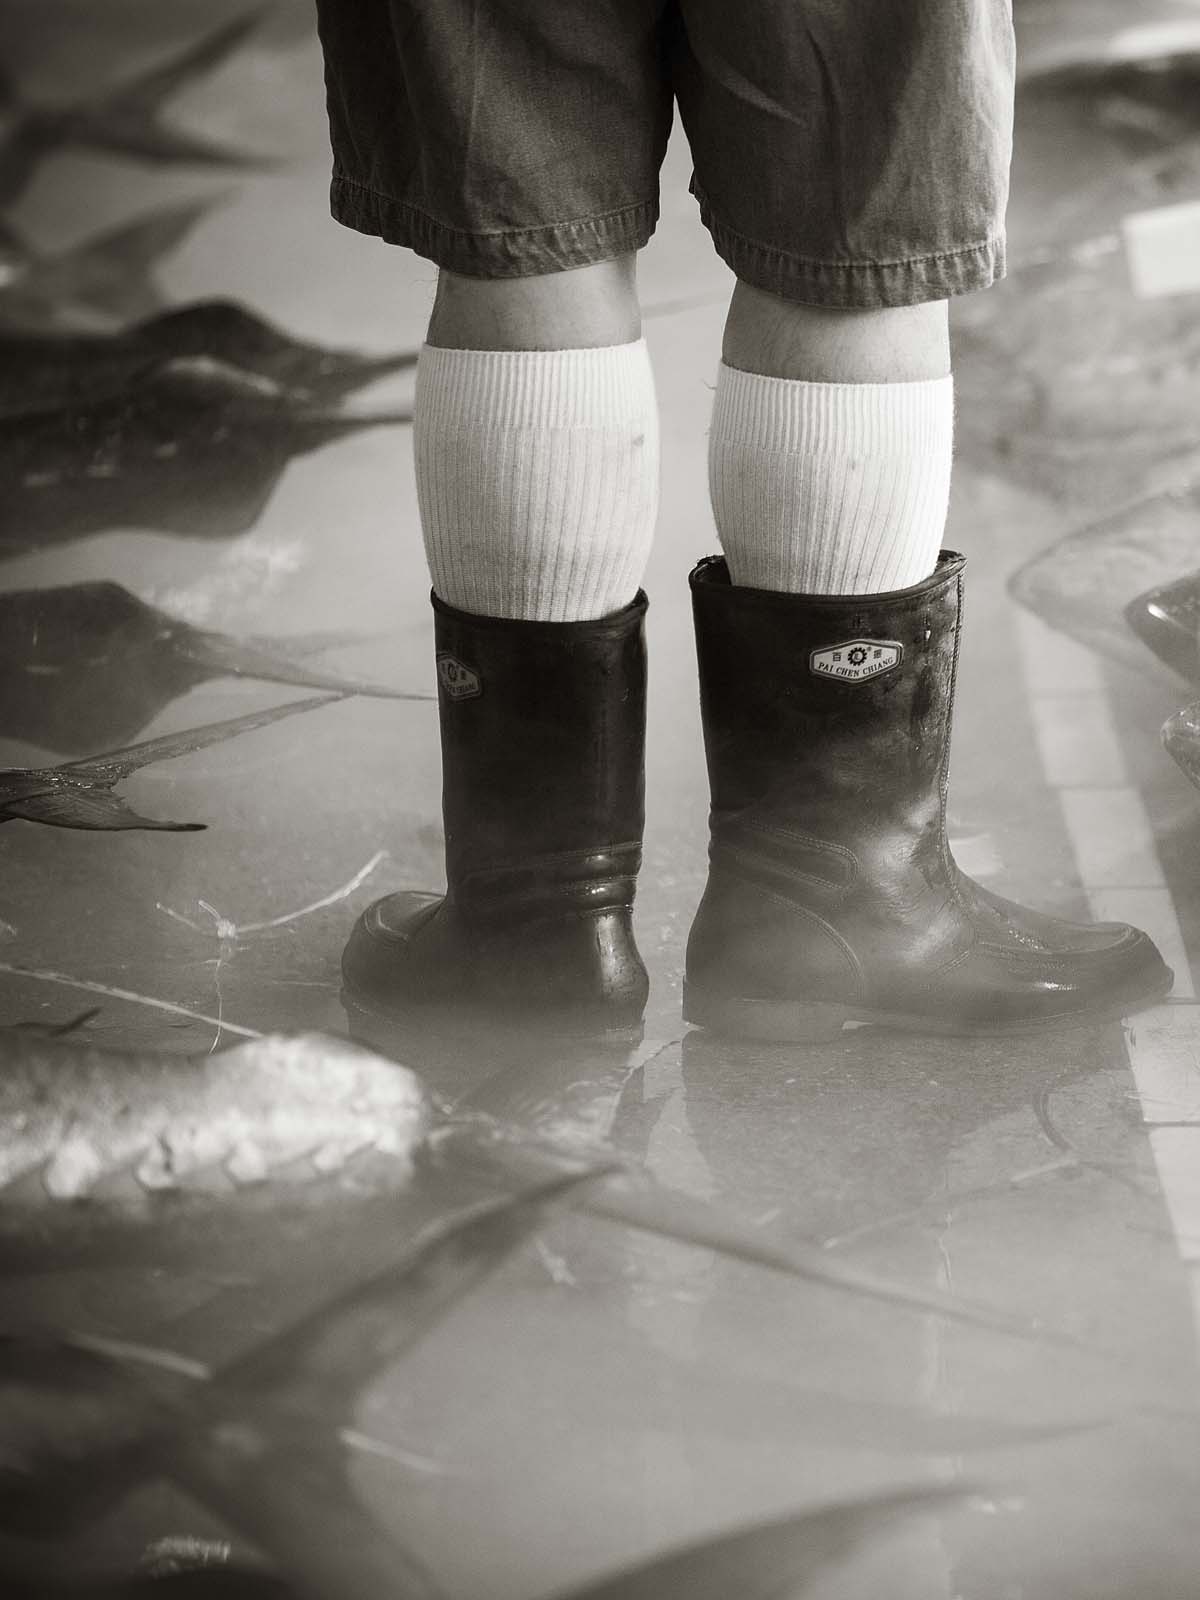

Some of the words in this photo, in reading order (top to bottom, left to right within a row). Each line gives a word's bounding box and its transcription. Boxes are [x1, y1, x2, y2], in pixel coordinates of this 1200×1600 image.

[818, 662, 833, 672] PAI
[836, 667, 859, 677] CHEN
[862, 657, 893, 675] CHIANG
